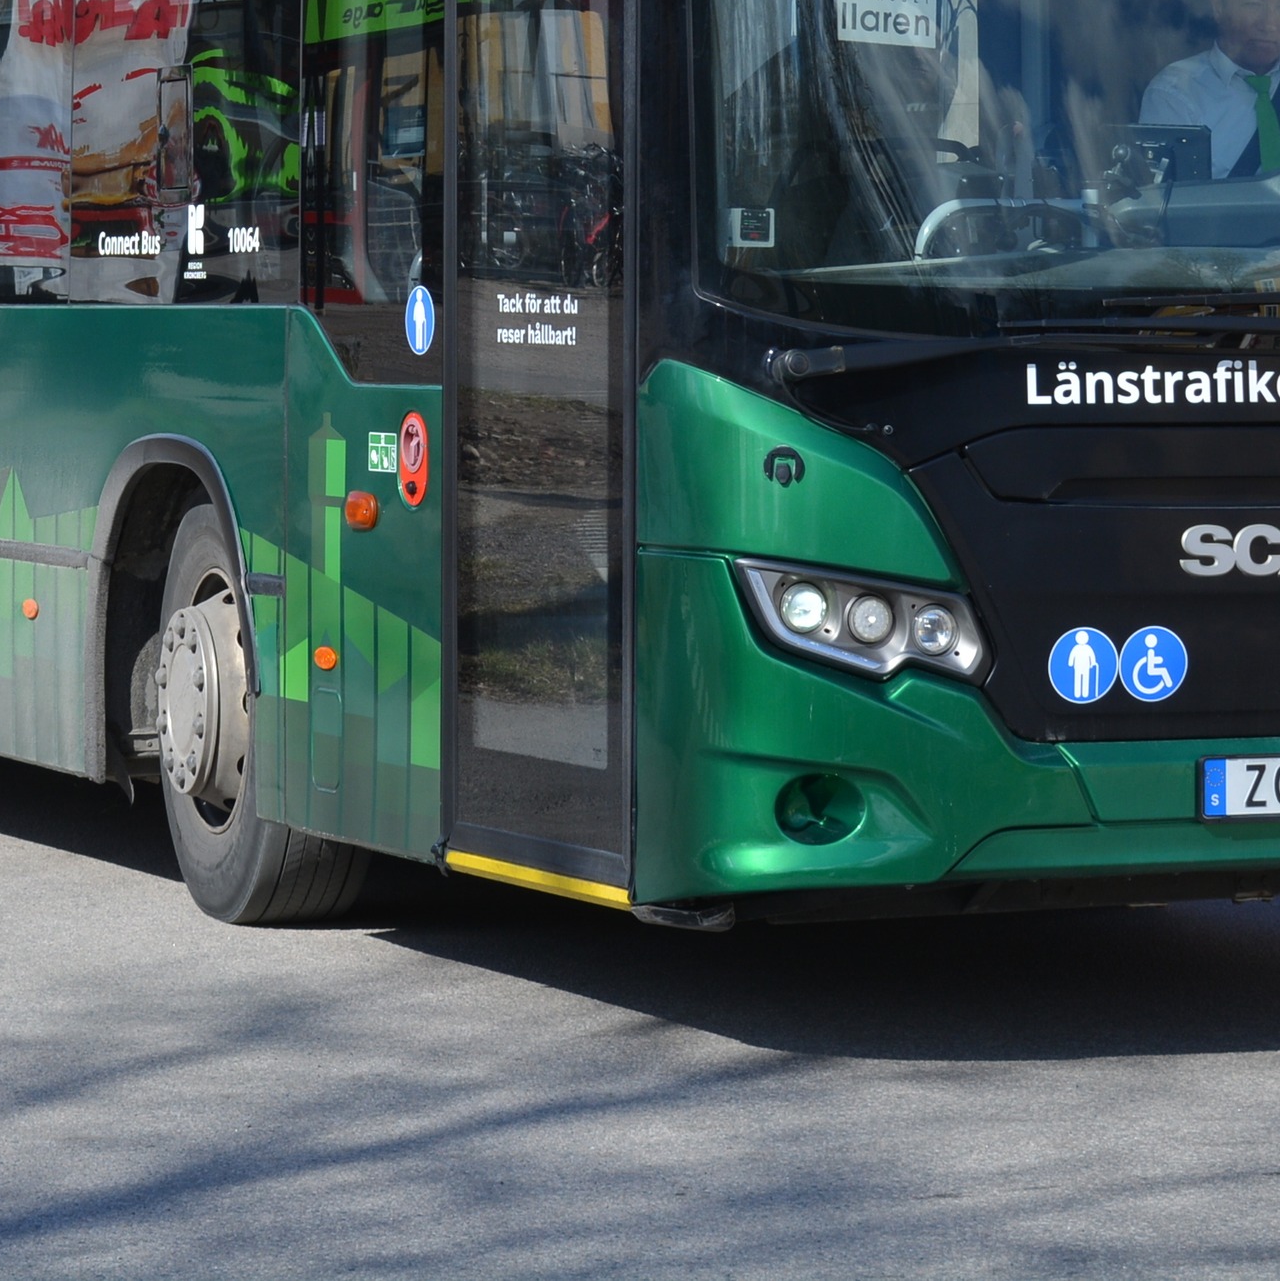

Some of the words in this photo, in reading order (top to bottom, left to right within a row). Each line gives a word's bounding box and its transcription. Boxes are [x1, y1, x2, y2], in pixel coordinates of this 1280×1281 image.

[98, 230, 141, 256] Connect
[141, 230, 161, 255] Bus
[227, 226, 260, 253] 10064
[496, 293, 523, 313] Tack
[524, 293, 542, 313] för
[543, 295, 561, 314] att
[563, 293, 578, 314] du
[496, 328, 526, 344] reser
[527, 322, 576, 346] hållbart!
[1210, 794, 1220, 806] S
